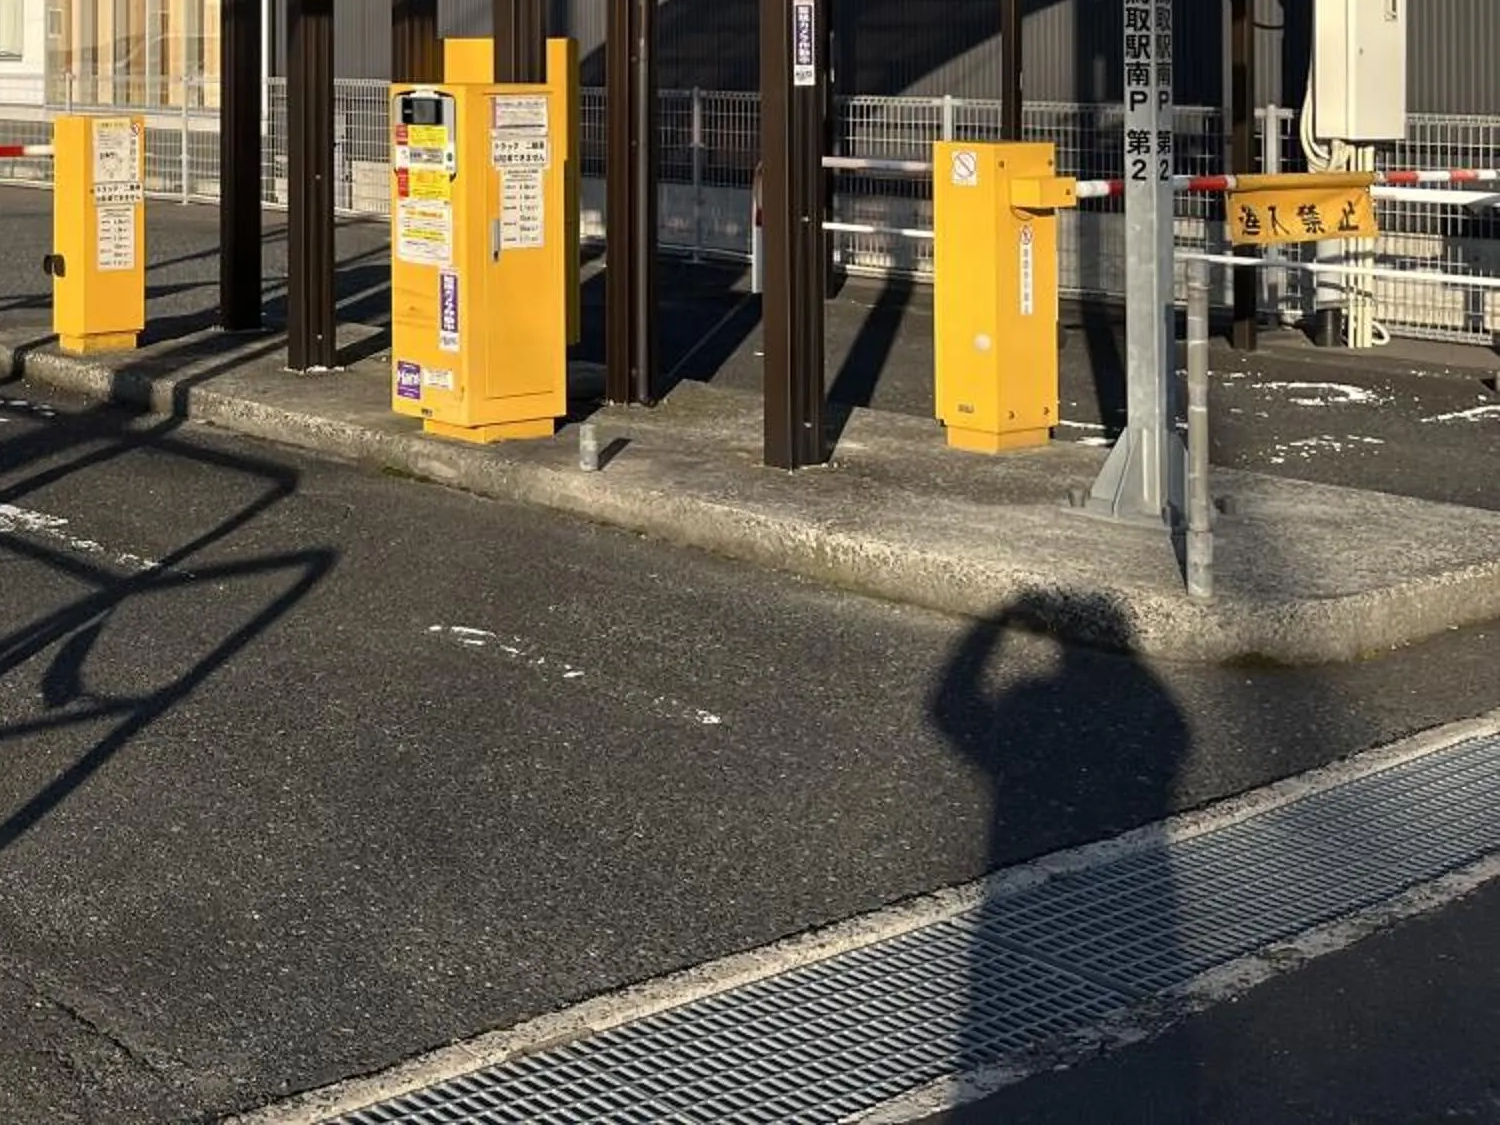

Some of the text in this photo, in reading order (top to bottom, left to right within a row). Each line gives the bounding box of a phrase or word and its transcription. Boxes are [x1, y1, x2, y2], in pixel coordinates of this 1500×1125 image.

[1127, 129, 1151, 182] 第2
[1238, 200, 1359, 236] 進入禁止
